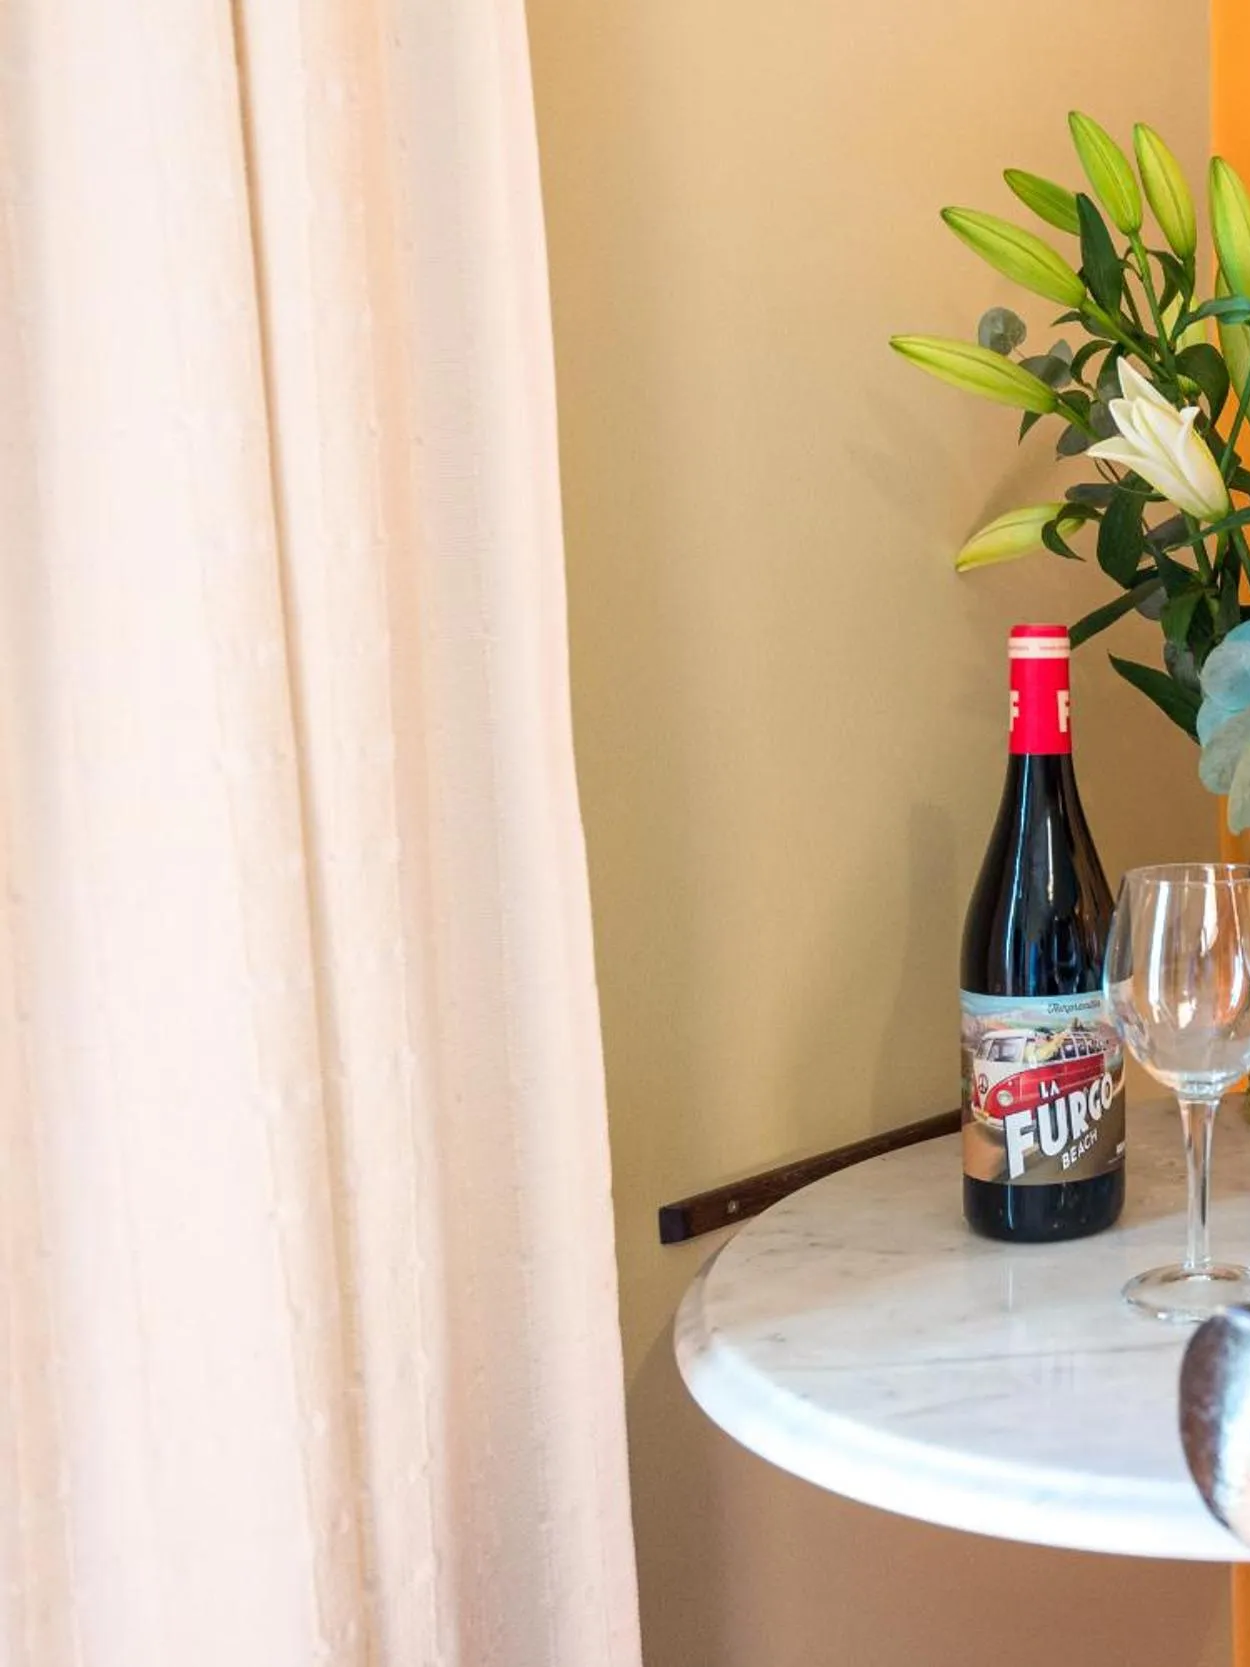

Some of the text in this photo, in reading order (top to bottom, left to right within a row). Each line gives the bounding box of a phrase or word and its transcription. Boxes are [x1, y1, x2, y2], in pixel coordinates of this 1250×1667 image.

[1040, 1080, 1060, 1098] LA
[1004, 1073, 1113, 1179] FURGO
[1062, 1128, 1098, 1170] BEACH
